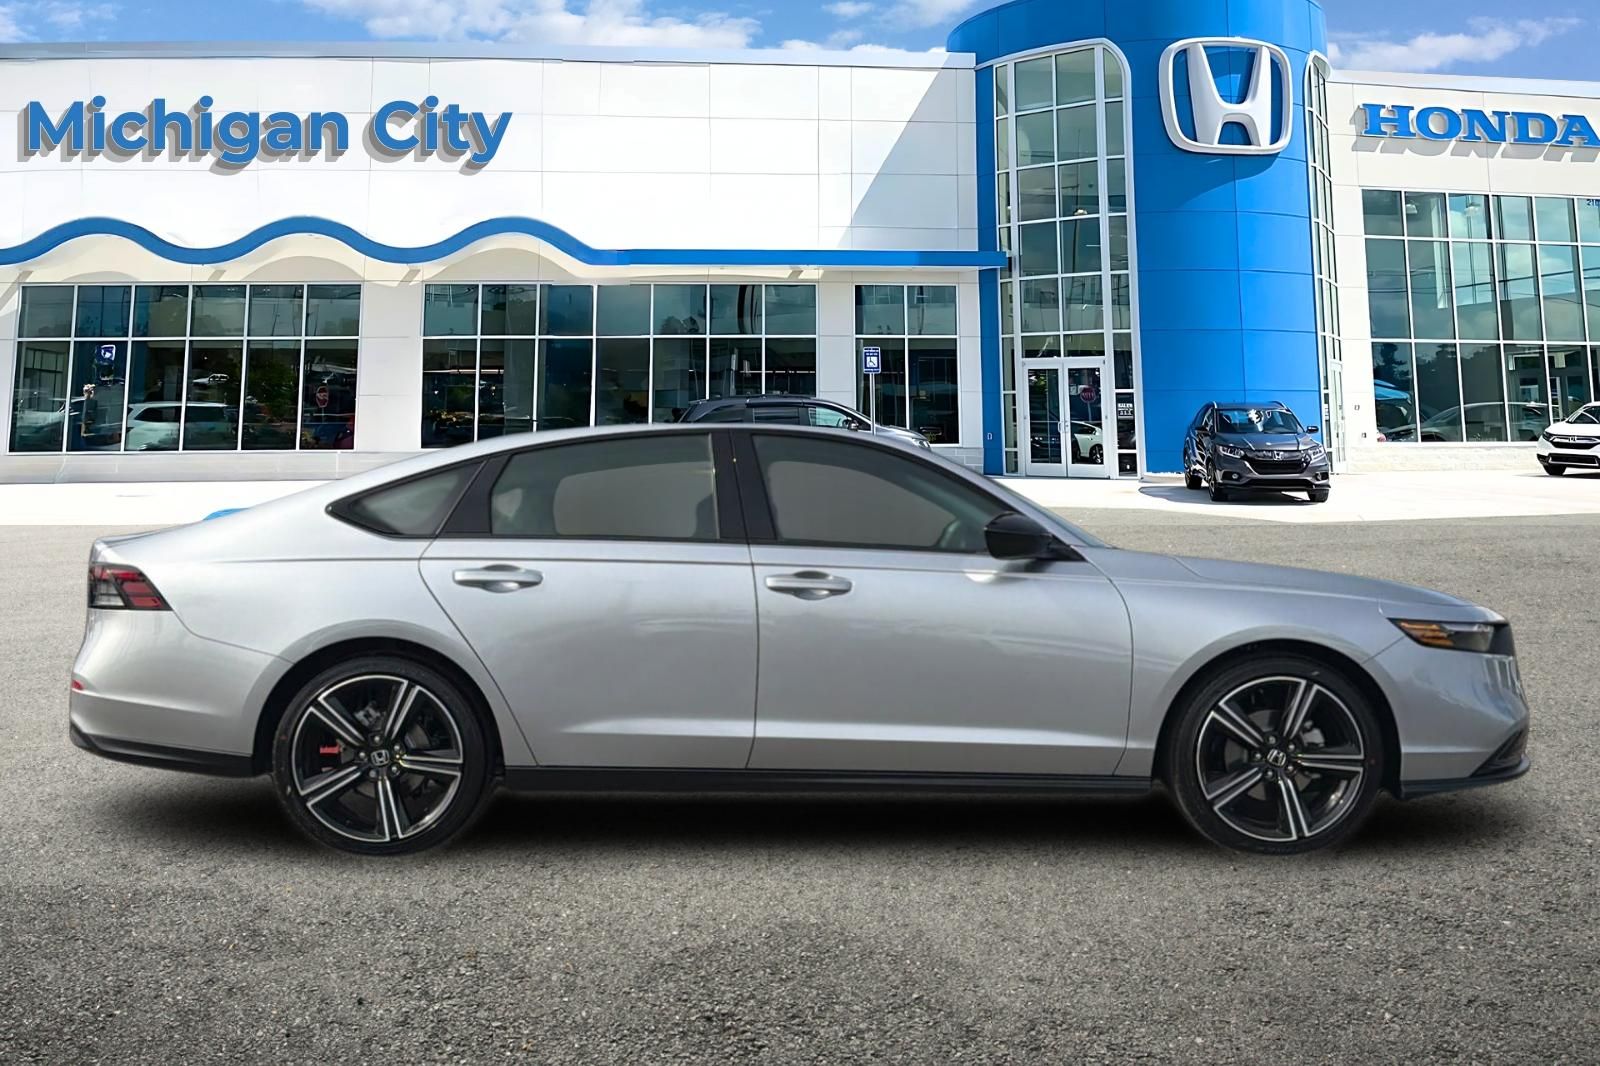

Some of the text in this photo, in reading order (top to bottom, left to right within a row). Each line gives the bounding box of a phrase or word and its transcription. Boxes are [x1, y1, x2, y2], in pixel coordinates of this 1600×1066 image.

[28, 95, 514, 165] Michigan City
[1361, 103, 1600, 148] HONDA
